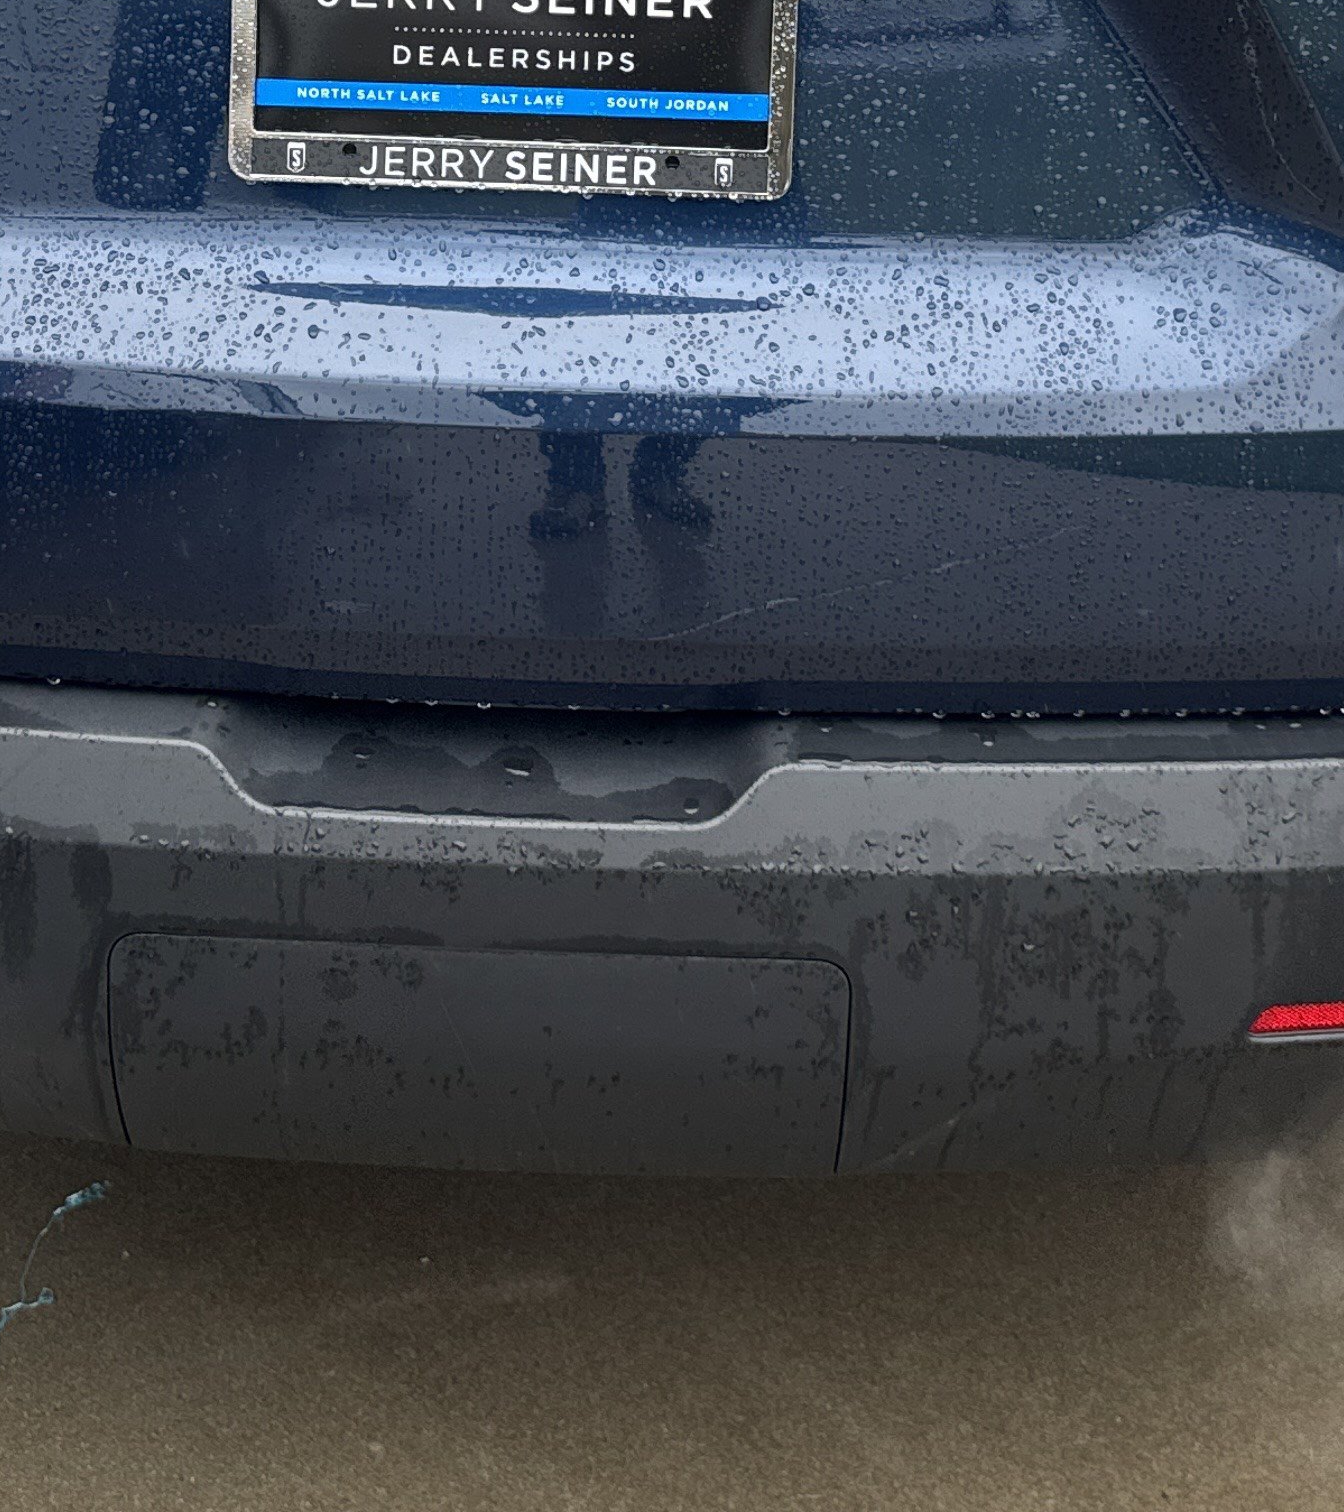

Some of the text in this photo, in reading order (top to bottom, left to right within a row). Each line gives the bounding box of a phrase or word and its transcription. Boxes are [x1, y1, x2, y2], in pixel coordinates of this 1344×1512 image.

[392, 44, 637, 73] DEALERSHIPS
[296, 87, 441, 103] NORTH SALT LAKE
[480, 92, 565, 108] SALT LAKE
[606, 96, 730, 113] SOUTH JORDAN
[359, 145, 657, 186] JERRY SEINER
